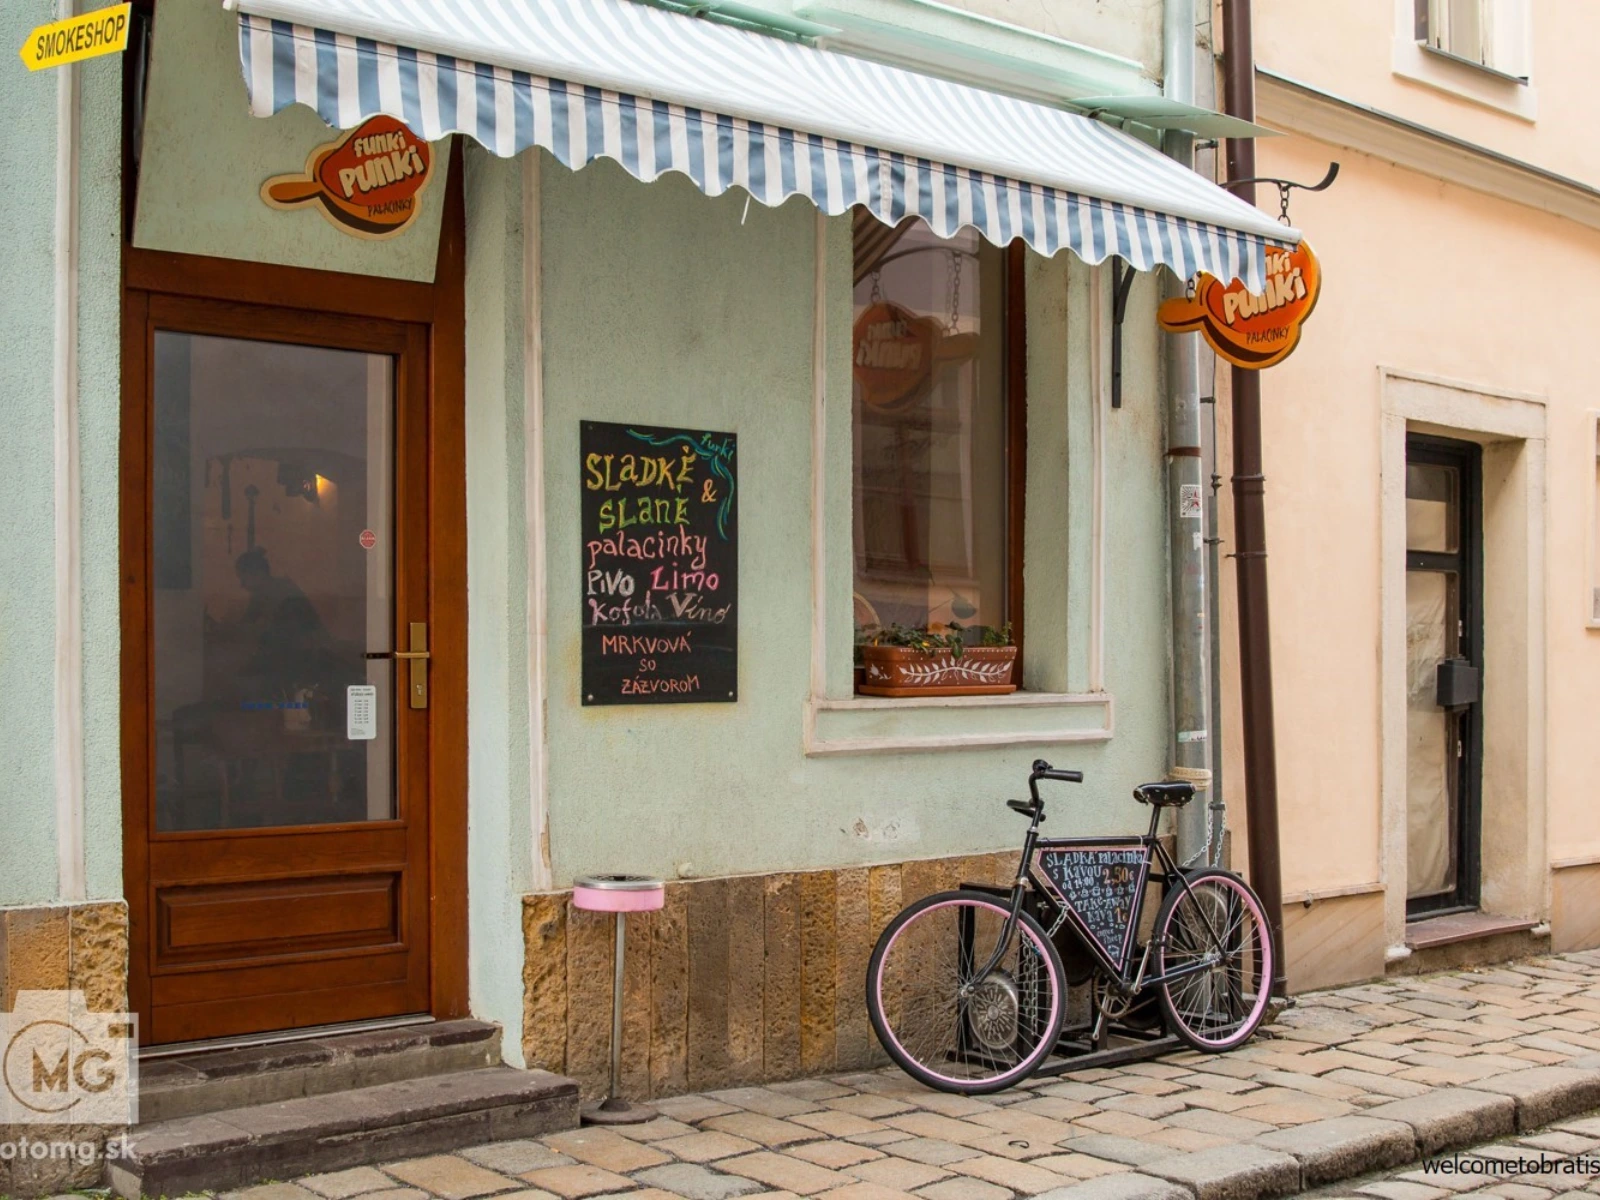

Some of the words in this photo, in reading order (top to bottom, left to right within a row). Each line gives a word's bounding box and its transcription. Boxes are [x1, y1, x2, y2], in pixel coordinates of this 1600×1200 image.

[36, 14, 125, 61] SMOKESHOP
[368, 198, 412, 217] PALACINKY
[1246, 326, 1290, 344] PALACINKY
[702, 479, 717, 503] &
[587, 524, 708, 571] palacinky
[650, 562, 719, 591] Limo
[602, 631, 692, 655] MRKVOVÁ
